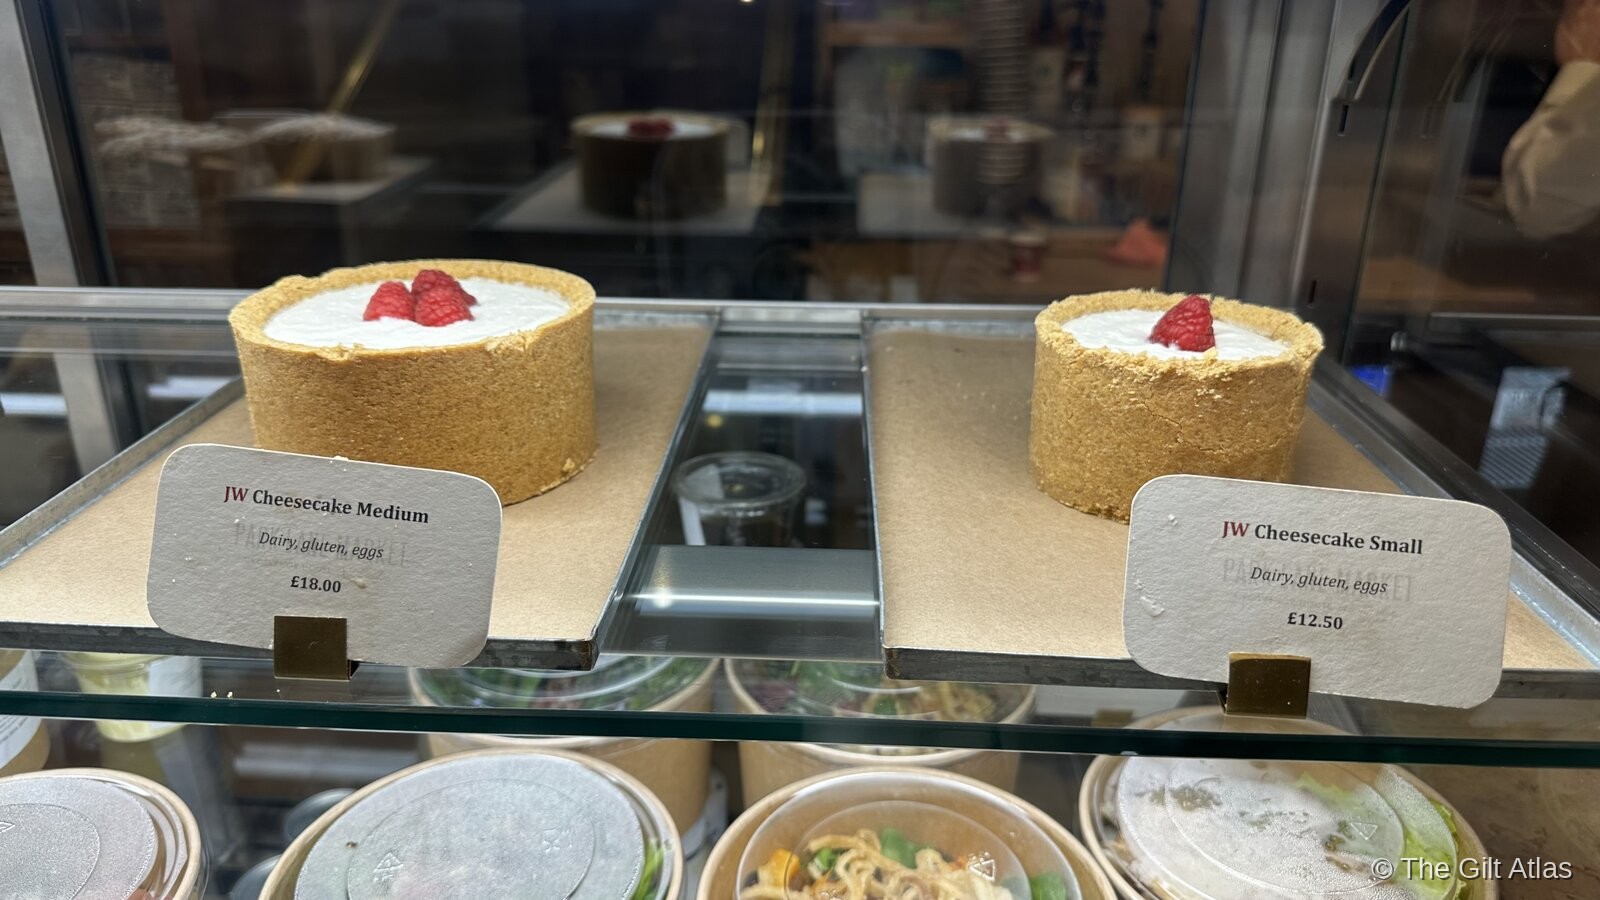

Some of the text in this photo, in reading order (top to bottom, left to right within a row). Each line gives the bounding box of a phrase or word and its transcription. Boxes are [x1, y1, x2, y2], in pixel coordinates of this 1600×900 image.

[224, 486, 430, 524] JW Cheesecake Medium
[259, 531, 384, 560] Dairy, gluten, eggs
[1221, 521, 1423, 555] JW Cheesecake Small
[290, 575, 342, 593] £18.00
[1250, 566, 1388, 595] Dairy, gluten, eggs
[1287, 612, 1343, 630] £12.50
